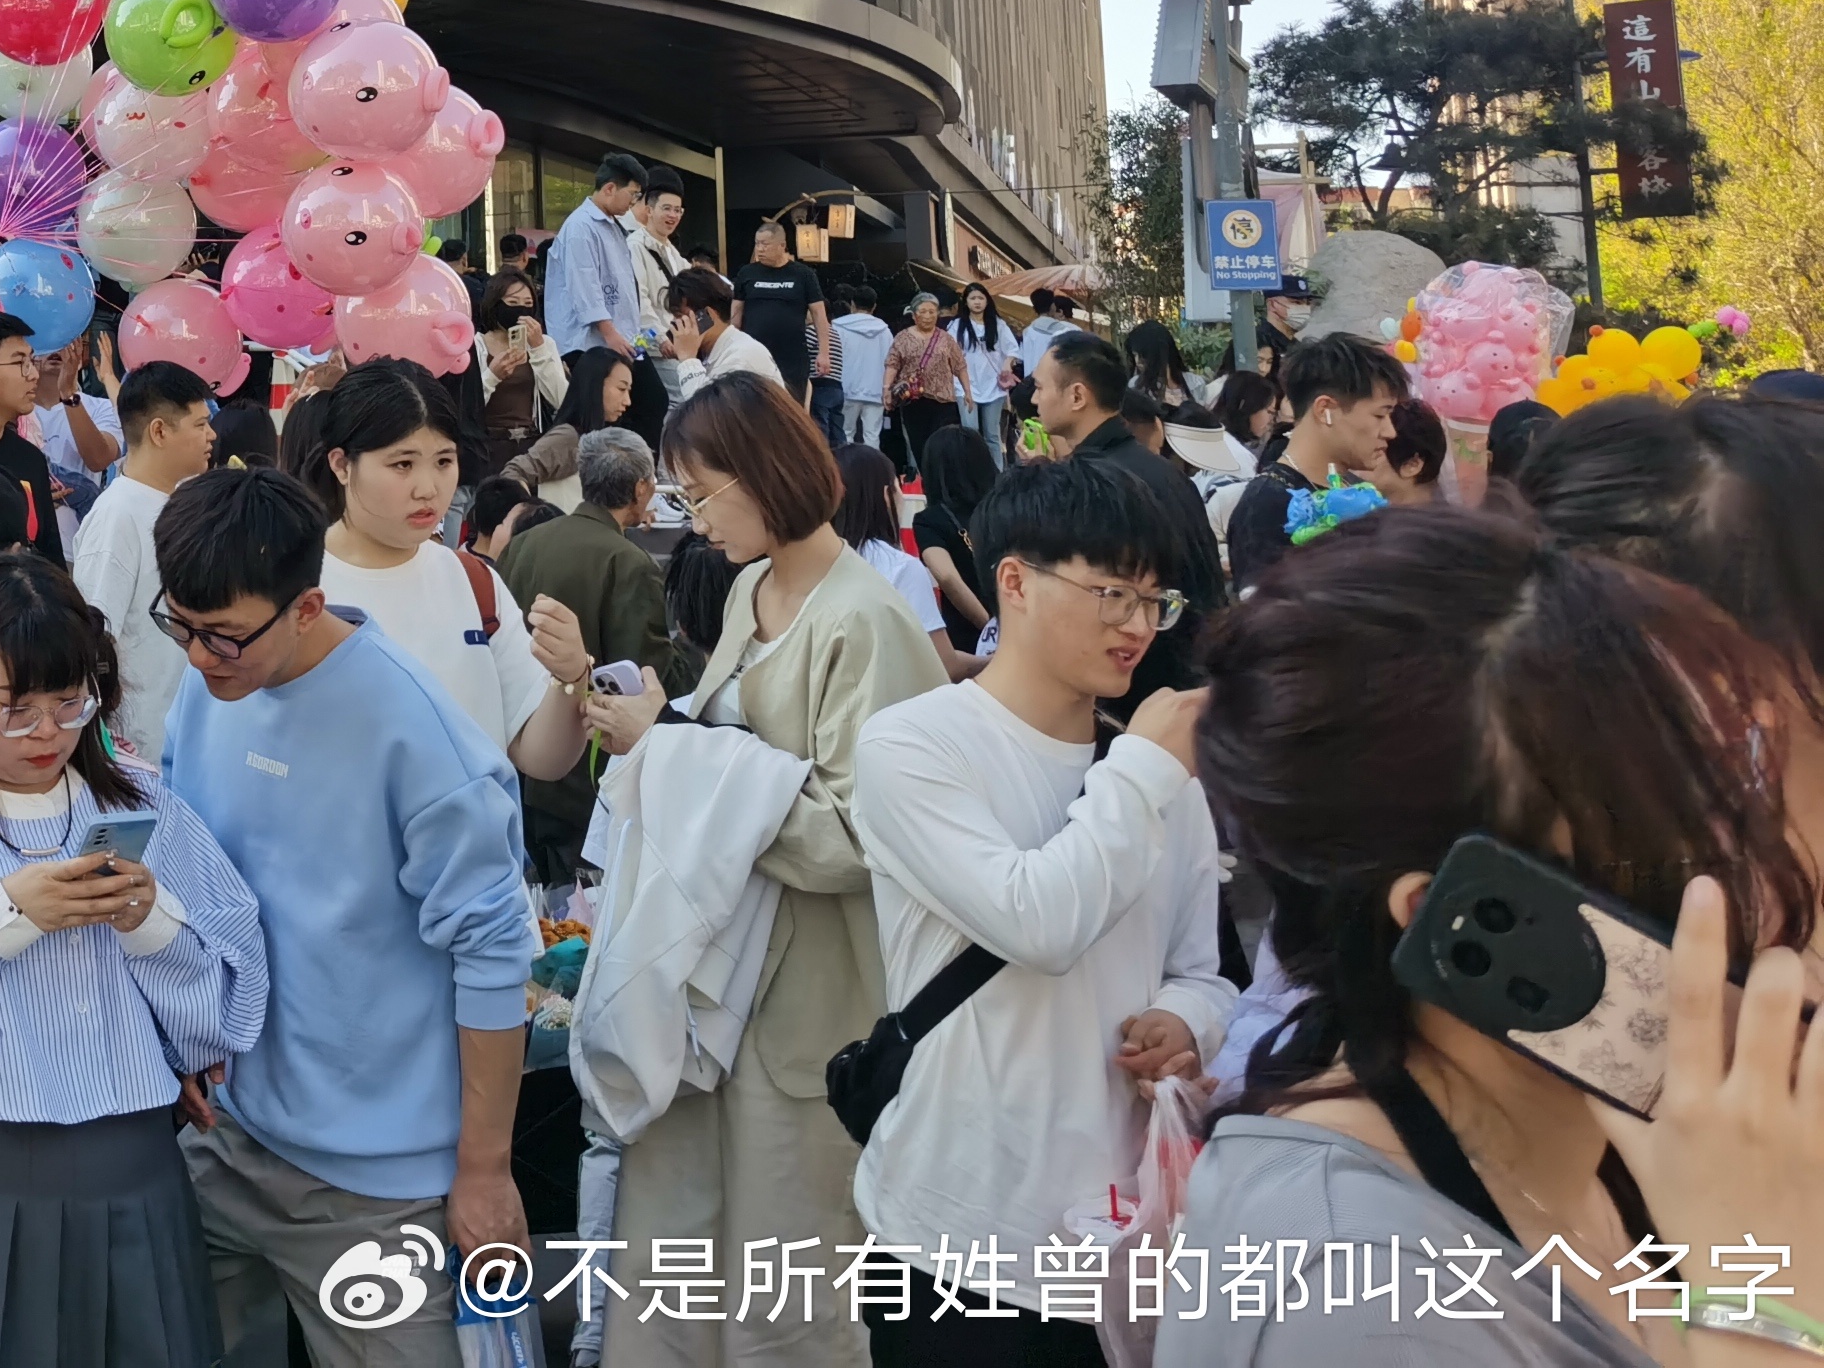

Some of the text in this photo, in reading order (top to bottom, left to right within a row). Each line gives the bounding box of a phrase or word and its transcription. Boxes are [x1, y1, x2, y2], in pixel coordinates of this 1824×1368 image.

[1214, 254, 1276, 269] 禁止停车
[1216, 271, 1276, 280] No Stopping
